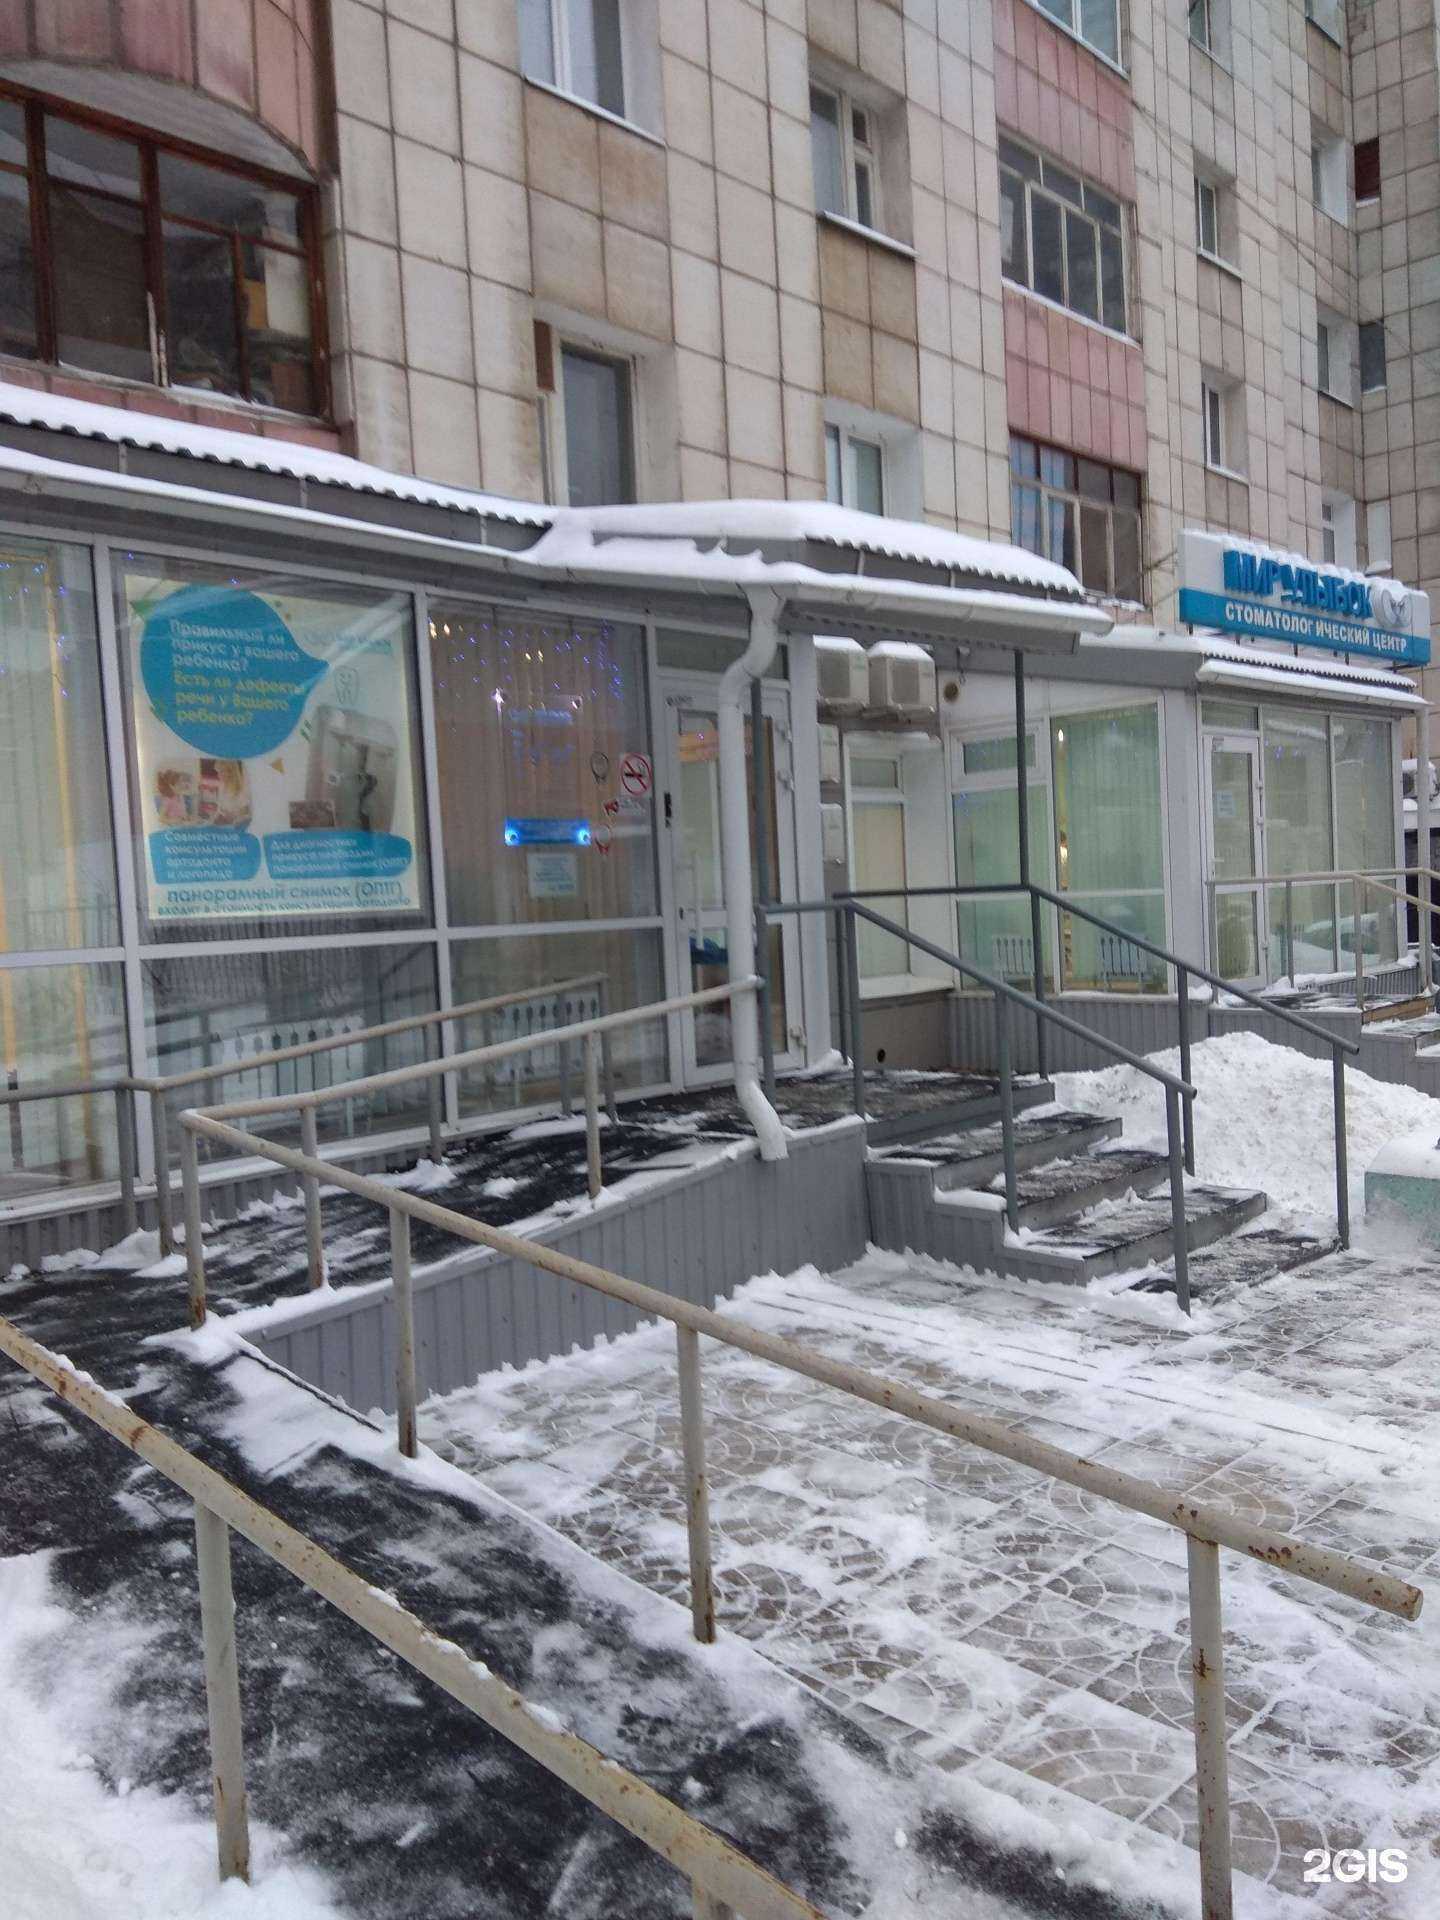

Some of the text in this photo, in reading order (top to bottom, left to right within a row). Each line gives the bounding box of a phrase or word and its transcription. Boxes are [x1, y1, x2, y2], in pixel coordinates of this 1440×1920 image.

[1223, 550, 1280, 597] МИР
[171, 620, 262, 641] Правильный
[269, 635, 285, 645] ли
[1225, 602, 1407, 653] СТОМАТОЛОГИЧЕСКИЙ ЦЕНТР
[172, 638, 226, 654] прикус
[231, 645, 240, 657] у
[173, 653, 248, 672] ребенка?
[174, 670, 210, 687] Есть
[215, 678, 230, 688] ли
[176, 692, 213, 705] речи
[167, 883, 286, 904] панорамный
[289, 886, 351, 898] снимок
